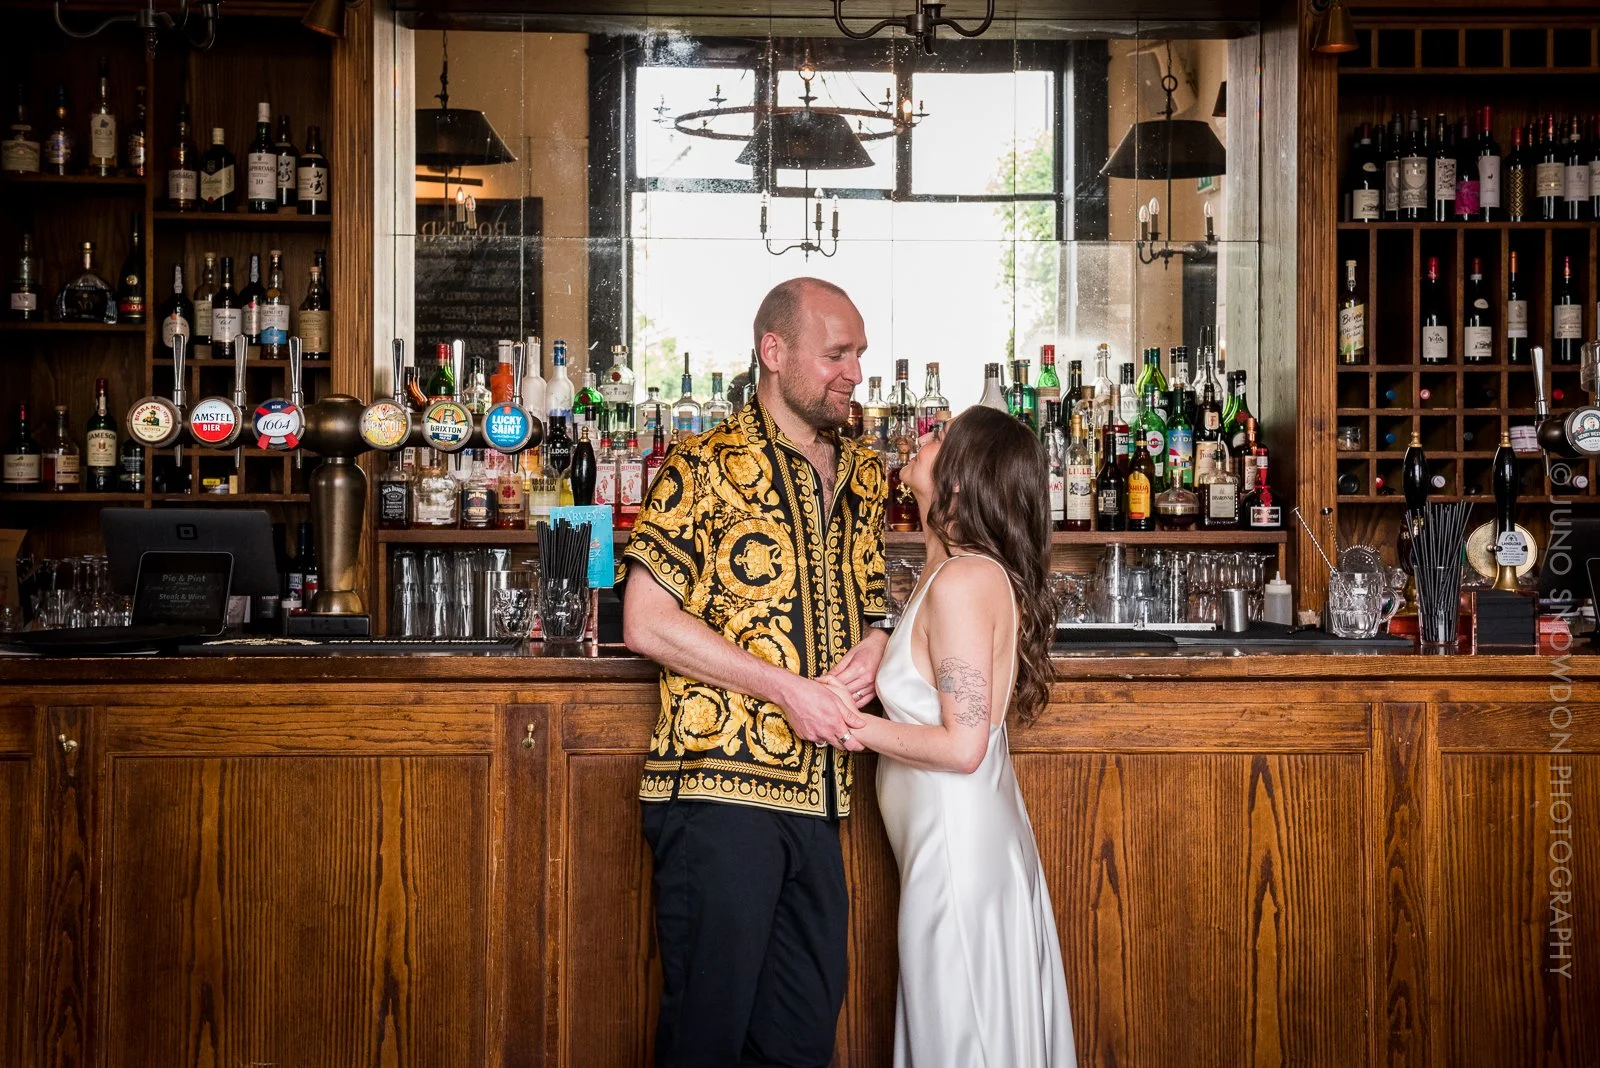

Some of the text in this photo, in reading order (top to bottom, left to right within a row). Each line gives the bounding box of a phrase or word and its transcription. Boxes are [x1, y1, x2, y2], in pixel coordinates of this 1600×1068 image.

[193, 413, 232, 422] AMSTEL
[492, 415, 522, 425] LUCKY
[202, 423, 221, 431] BIER
[263, 419, 291, 430] 1664
[491, 424, 521, 434] SAINT
[430, 425, 462, 434] BRIXTON
[88, 432, 116, 440] JAMESON
[1049, 480, 1063, 491] MM'S
[162, 574, 177, 582] Pie
[187, 574, 207, 583] Pint
